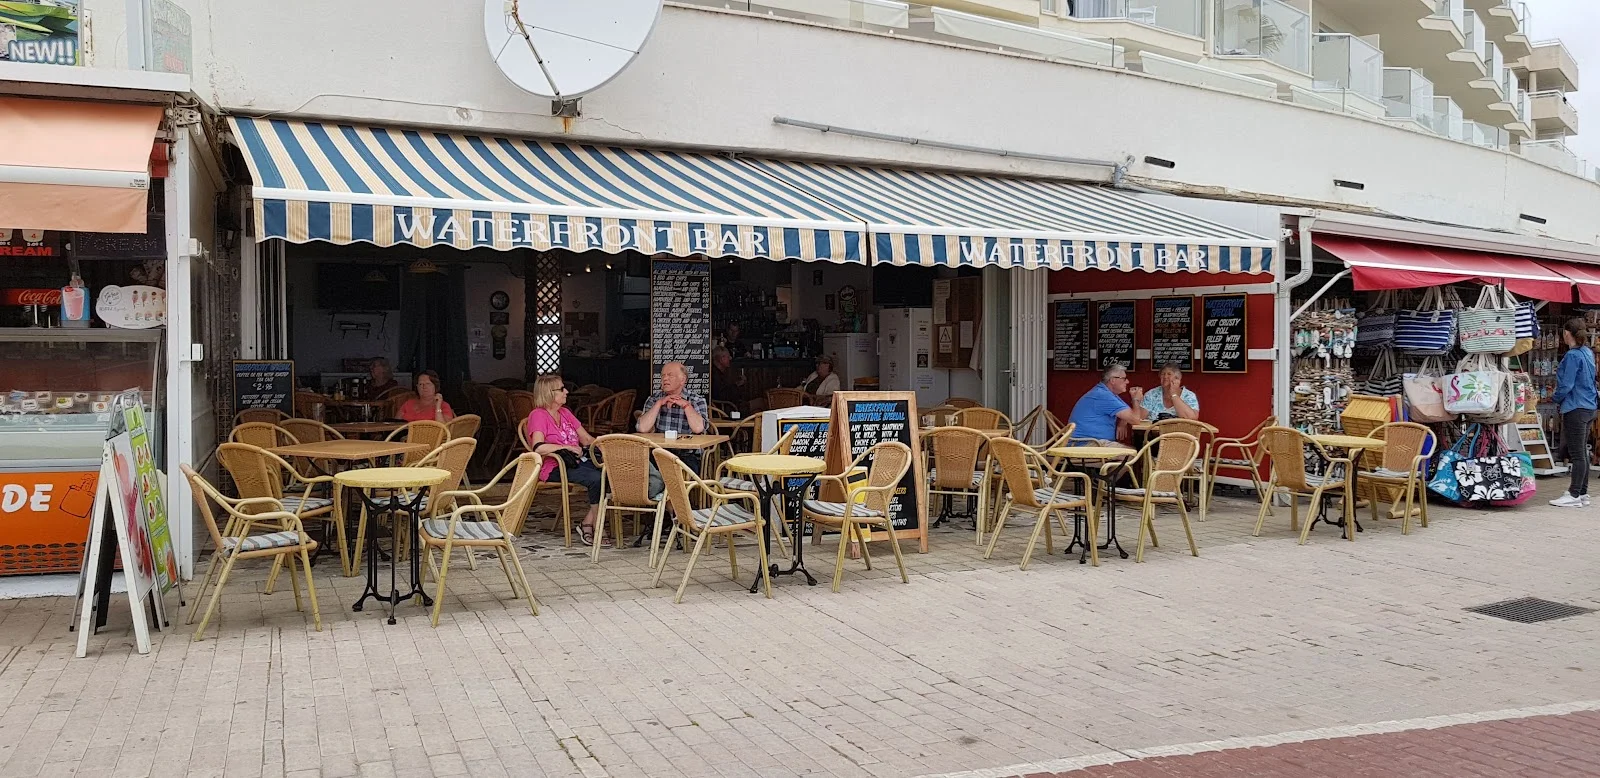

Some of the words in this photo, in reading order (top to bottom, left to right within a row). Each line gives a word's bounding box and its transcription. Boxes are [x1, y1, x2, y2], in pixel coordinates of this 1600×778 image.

[10, 40, 75, 64] NEW!!
[395, 213, 683, 249] WATERFRONT
[694, 228, 766, 254] BAR
[0, 246, 52, 257] REAM
[960, 241, 1149, 267] WATERFRONT
[1156, 248, 1208, 268] BAR
[18, 289, 62, 306] Coca-Col
[1205, 298, 1244, 309] WATERFRONT
[1211, 308, 1235, 318] SPECIAL
[1206, 318, 1219, 327] HOT
[1218, 318, 1241, 327] CRUSTY
[1215, 327, 1230, 335] ROLL
[1205, 335, 1223, 343] FILLED
[1225, 335, 1242, 343] WITH
[1205, 343, 1222, 351] ROAST
[1223, 343, 1239, 351] BEEF
[1221, 351, 1240, 359] SALAD
[855, 403, 897, 412] WATERFRONT
[849, 412, 882, 422] LUNCHTIME
[882, 412, 905, 421] SPECIAL
[851, 424, 861, 432] ANY
[881, 423, 904, 431] SANDWICH
[854, 431, 862, 439] OR
[854, 438, 869, 446] CHOICE
[2, 483, 54, 513] DE
